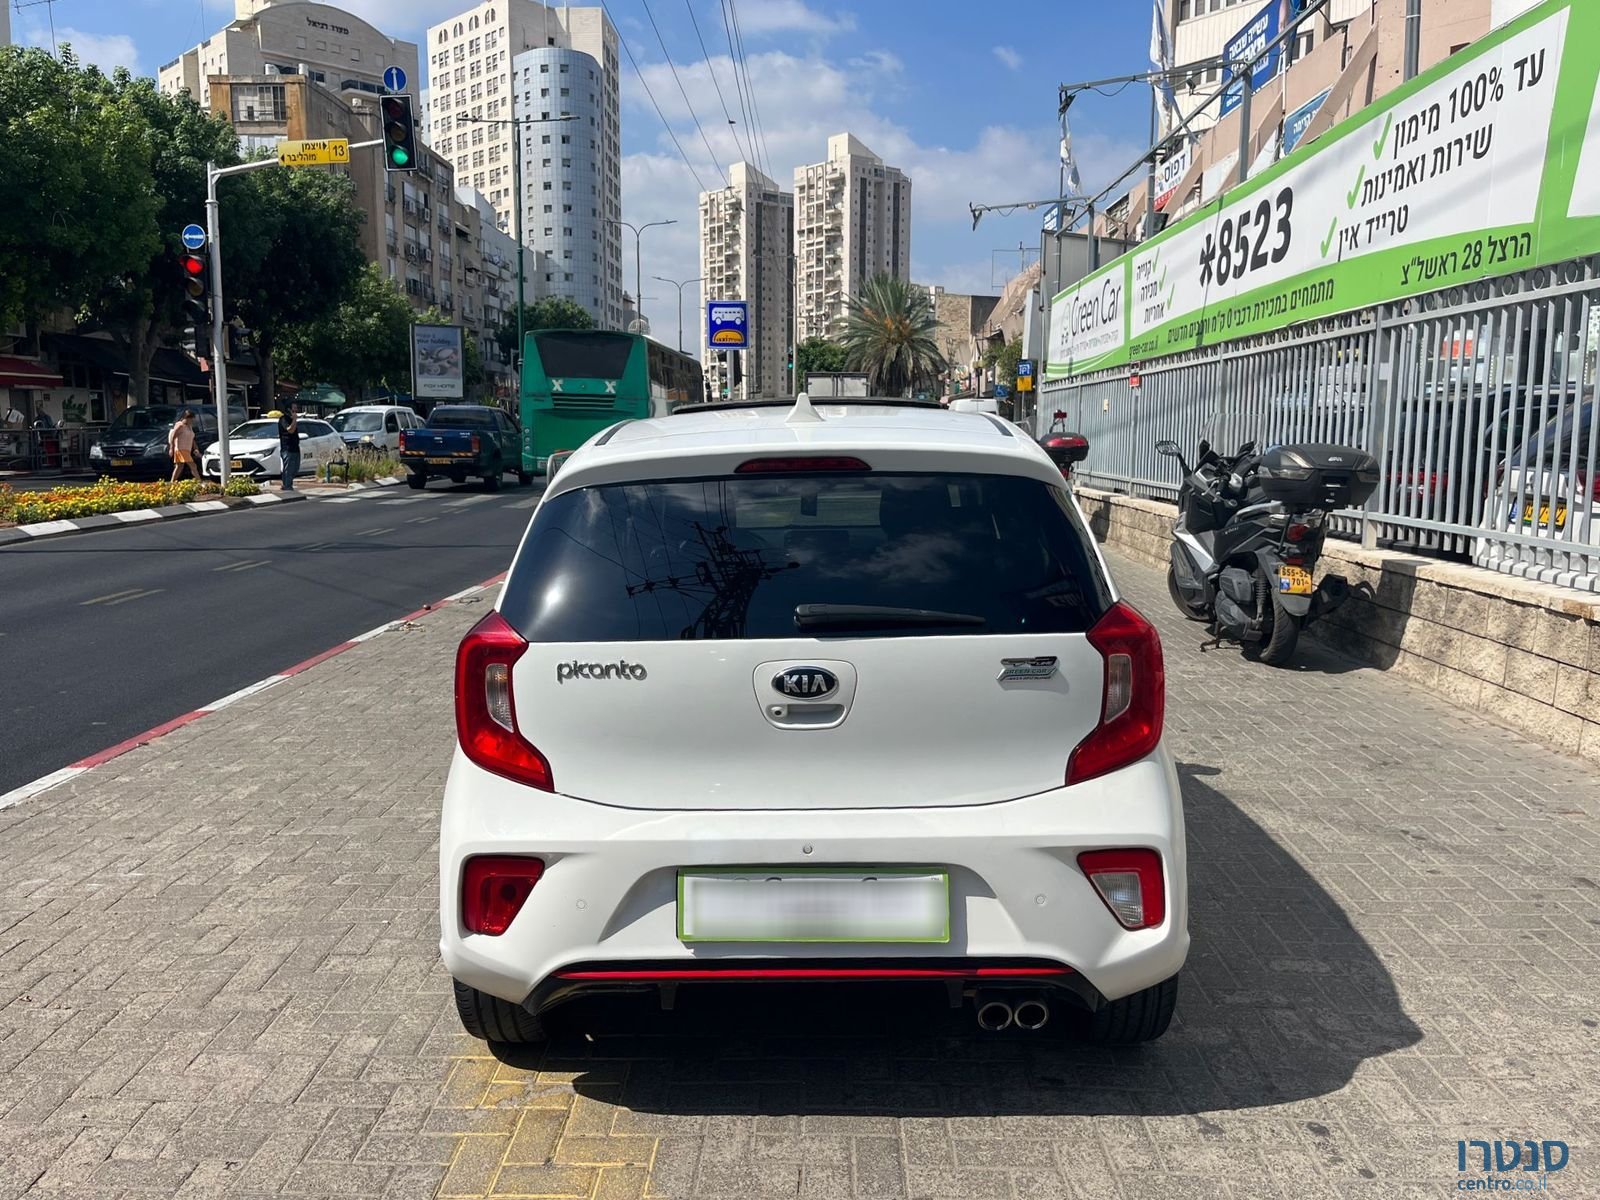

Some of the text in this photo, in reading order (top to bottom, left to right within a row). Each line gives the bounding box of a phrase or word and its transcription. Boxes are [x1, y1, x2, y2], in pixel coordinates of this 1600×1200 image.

[1393, 48, 1545, 160] עד 100% מימון
[301, 142, 321, 152] ויצמן
[333, 145, 345, 156] 13
[1165, 153, 1186, 182] דפוס
[1361, 123, 1493, 207] שירות ואמינות
[1338, 204, 1409, 262] טרייד אין
[1461, 240, 1483, 271] 28
[1488, 232, 1532, 264] הרצל
[1141, 281, 1158, 302] מכירה
[1290, 278, 1334, 310] מתמחים
[1072, 279, 1121, 336] Green Car
[1234, 306, 1251, 326] רכבי
[1252, 294, 1287, 322] במכירת
[1168, 325, 1188, 343] חדשים
[557, 660, 648, 685] picanto
[783, 674, 828, 693] KIA
